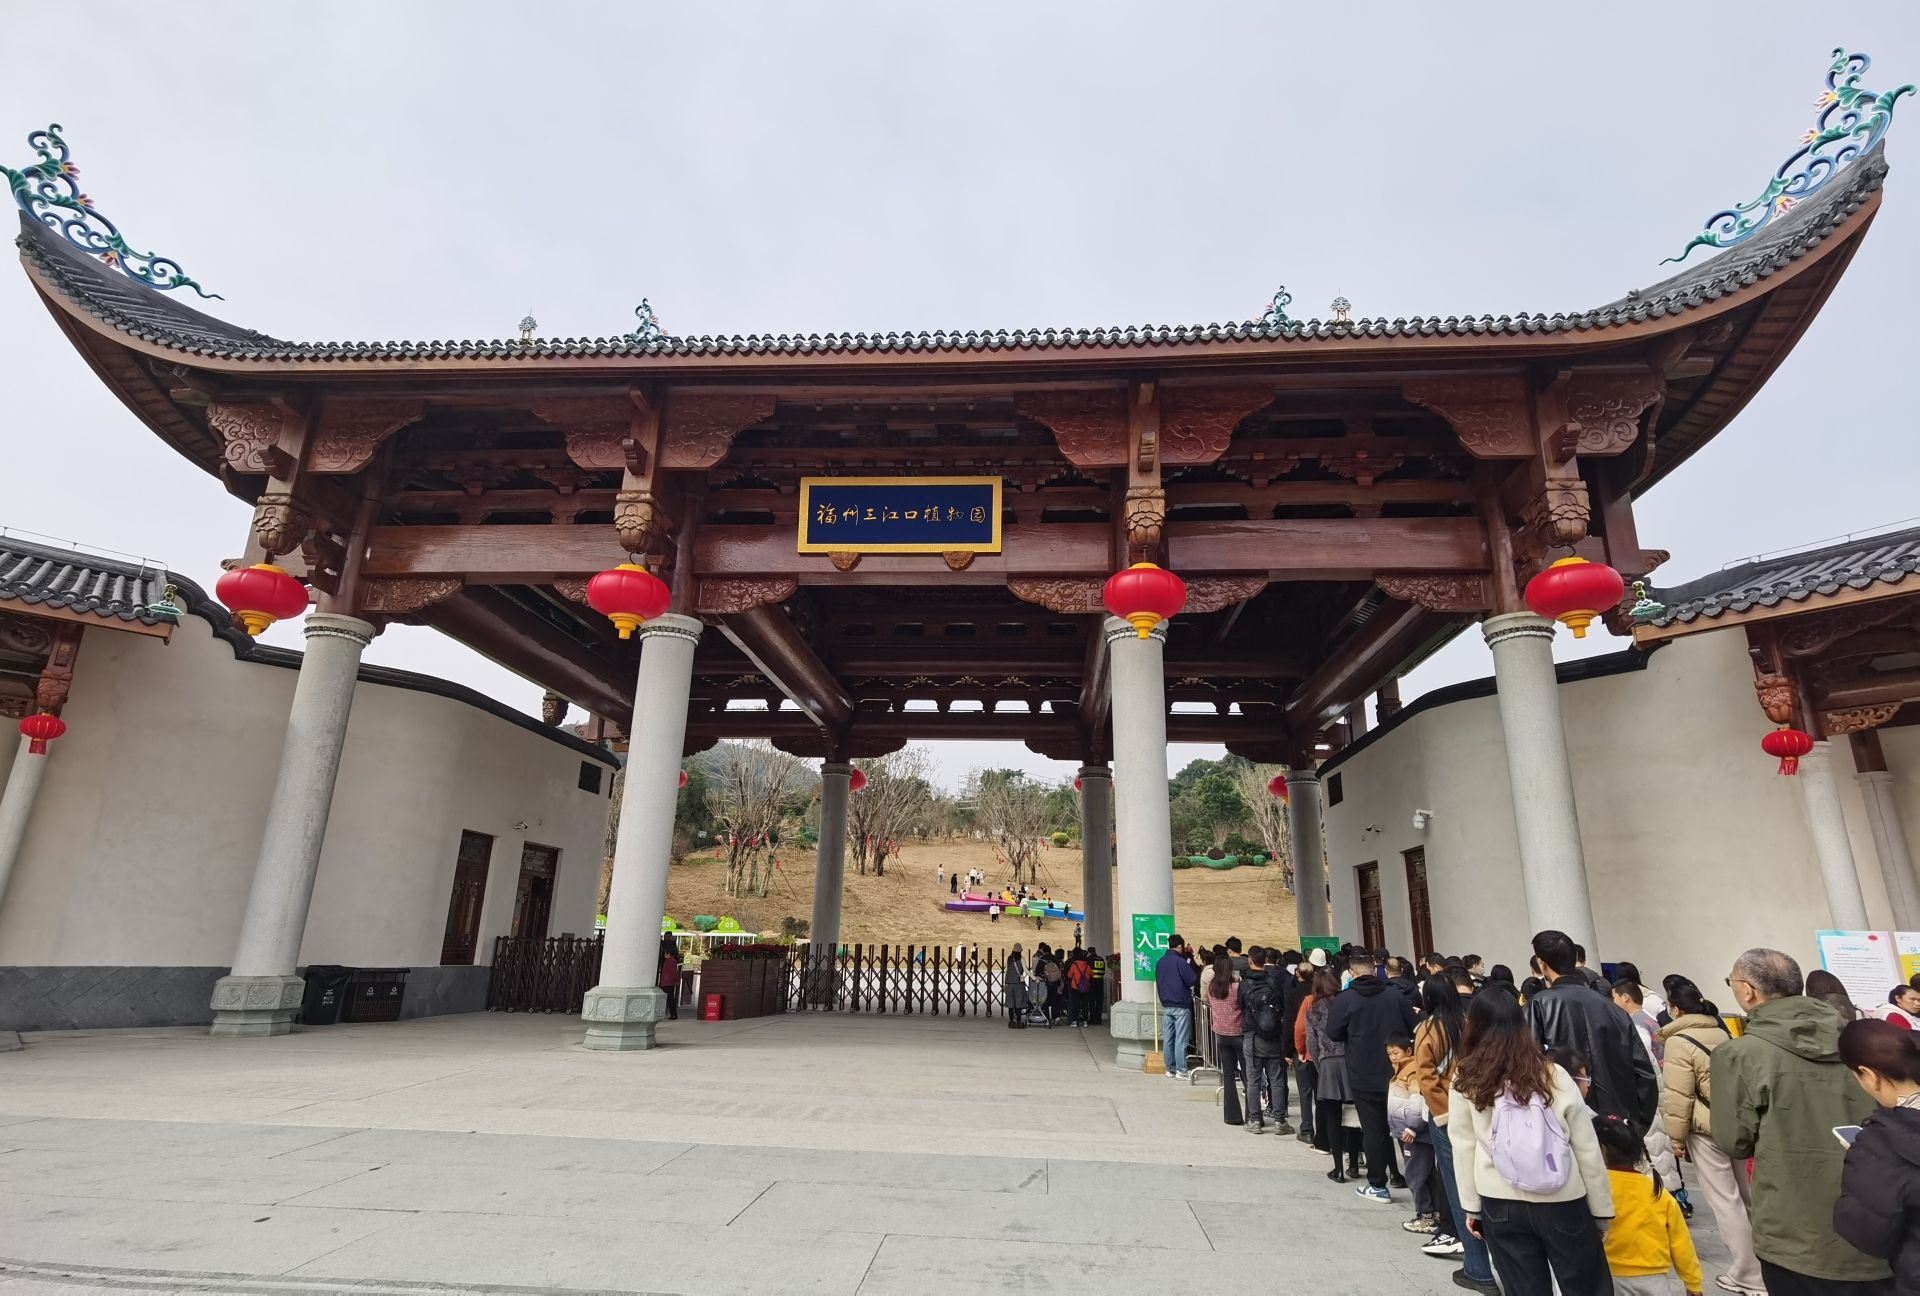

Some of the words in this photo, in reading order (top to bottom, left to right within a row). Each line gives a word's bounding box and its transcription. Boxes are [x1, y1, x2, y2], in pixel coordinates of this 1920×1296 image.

[816, 503, 986, 526] 福州三江口植物园
[1137, 931, 1170, 949] 入口
